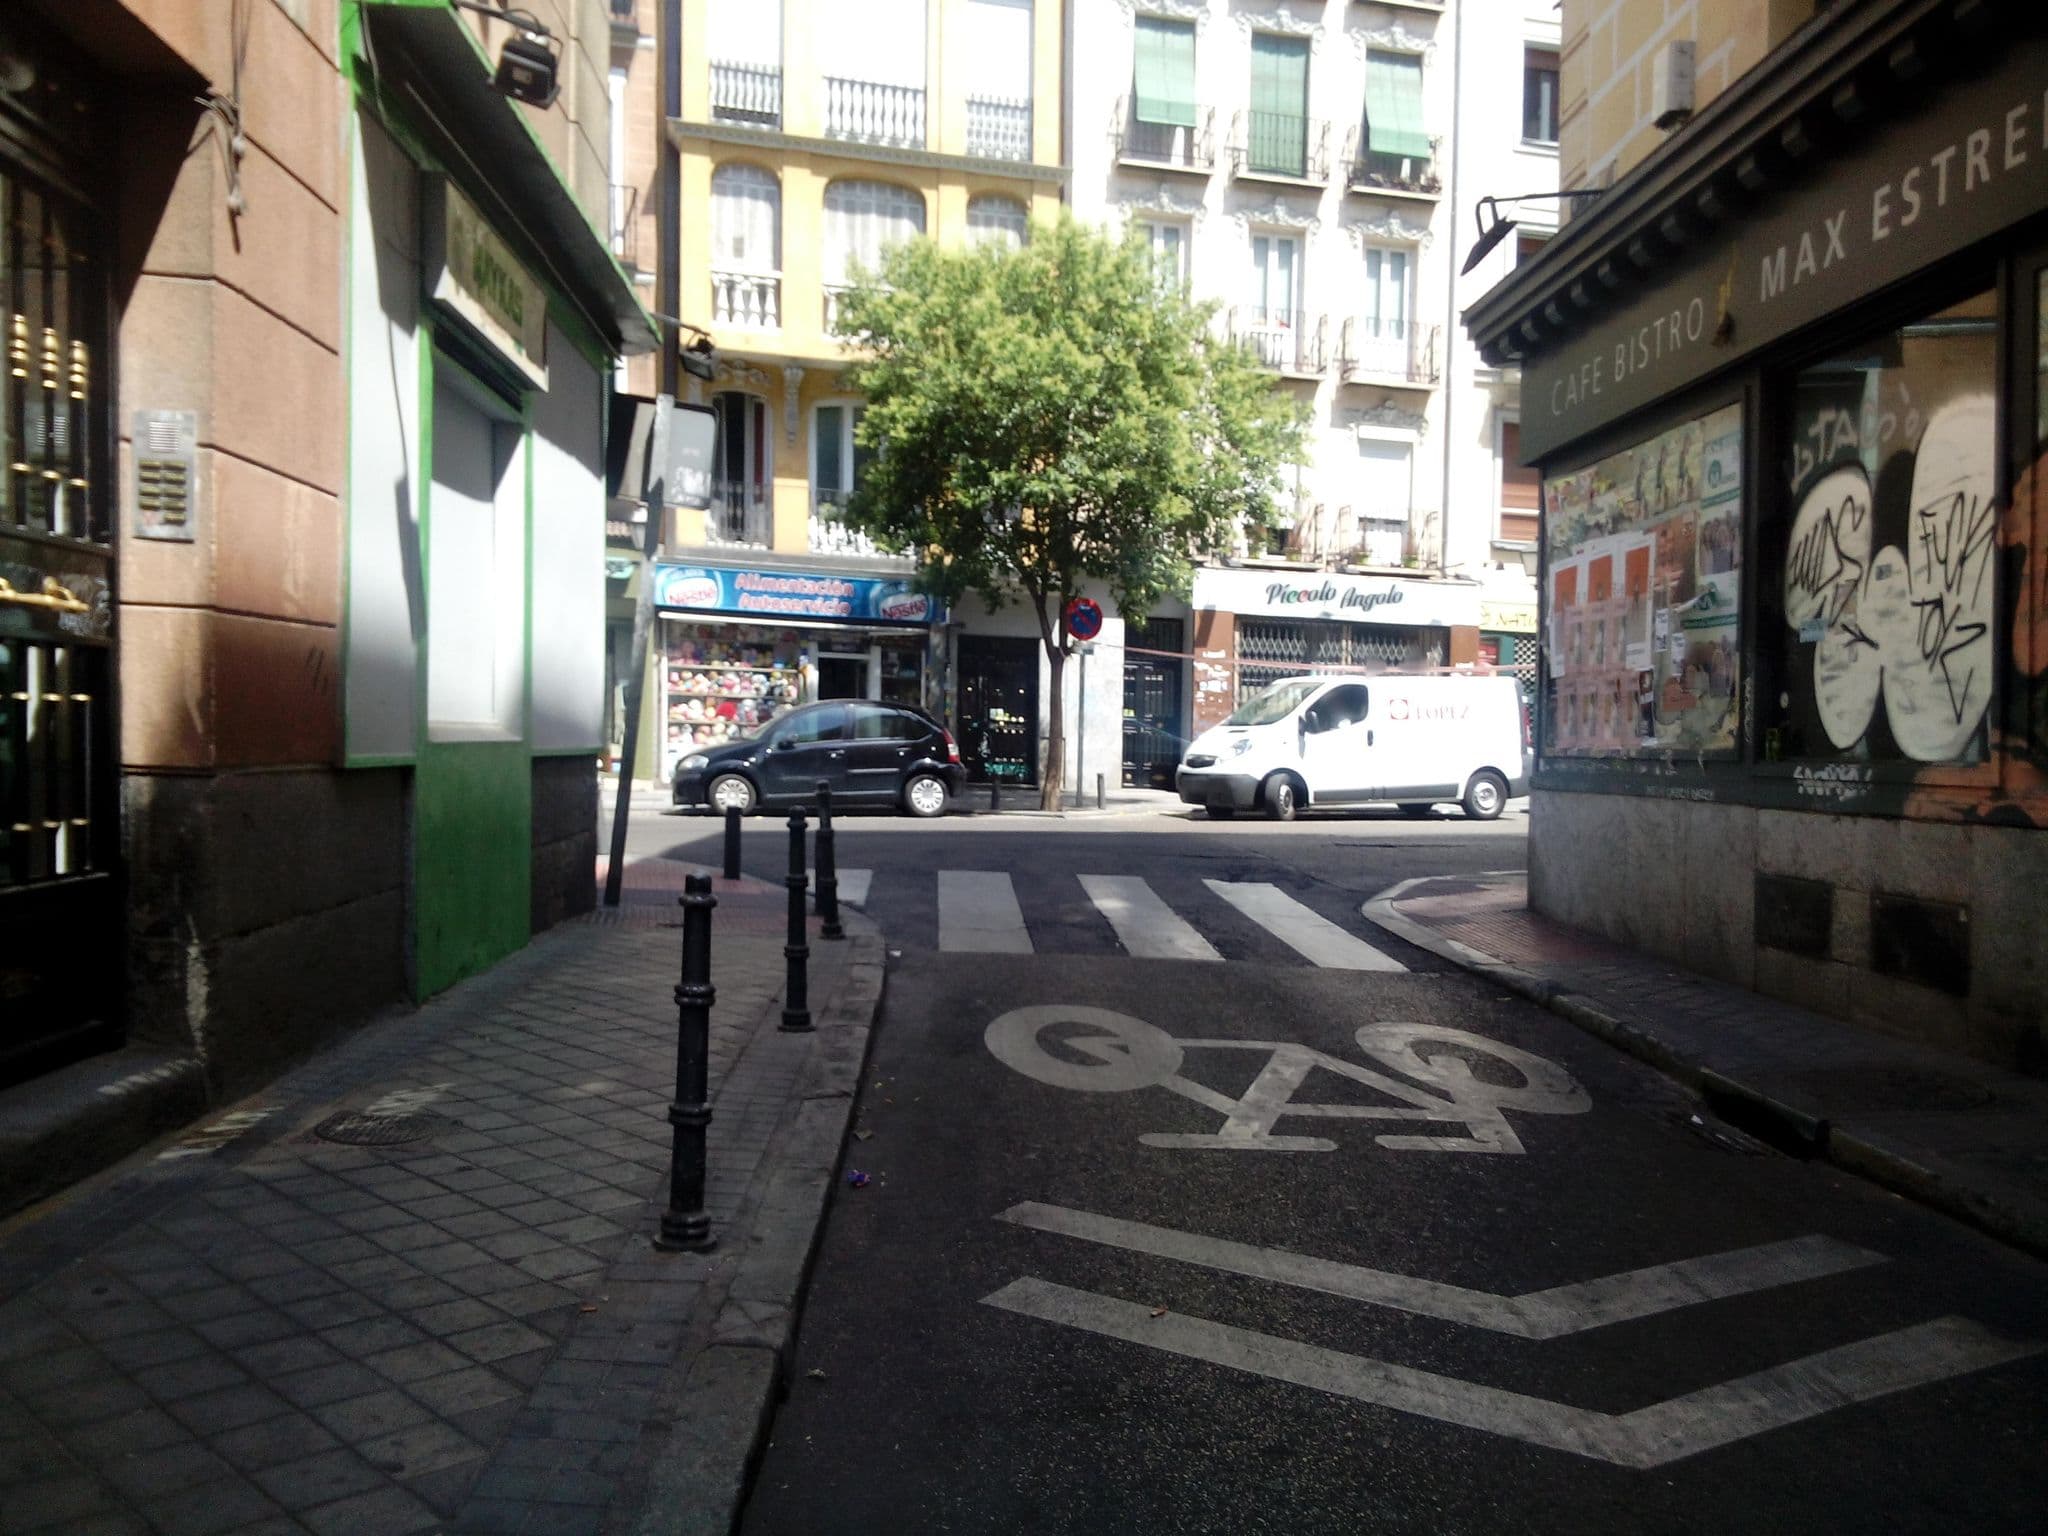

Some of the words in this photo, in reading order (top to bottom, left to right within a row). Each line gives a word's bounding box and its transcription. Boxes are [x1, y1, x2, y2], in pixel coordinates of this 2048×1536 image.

[1551, 356, 1603, 417] CAFE
[1614, 297, 1704, 383] BISTRO
[1760, 209, 1847, 303] MAX
[1871, 89, 2048, 243] ESTRE
[734, 572, 855, 598] Alimentación
[1265, 580, 1337, 605] Piccolo
[1339, 584, 1404, 612] Angolo
[737, 591, 852, 618] Autoservicio
